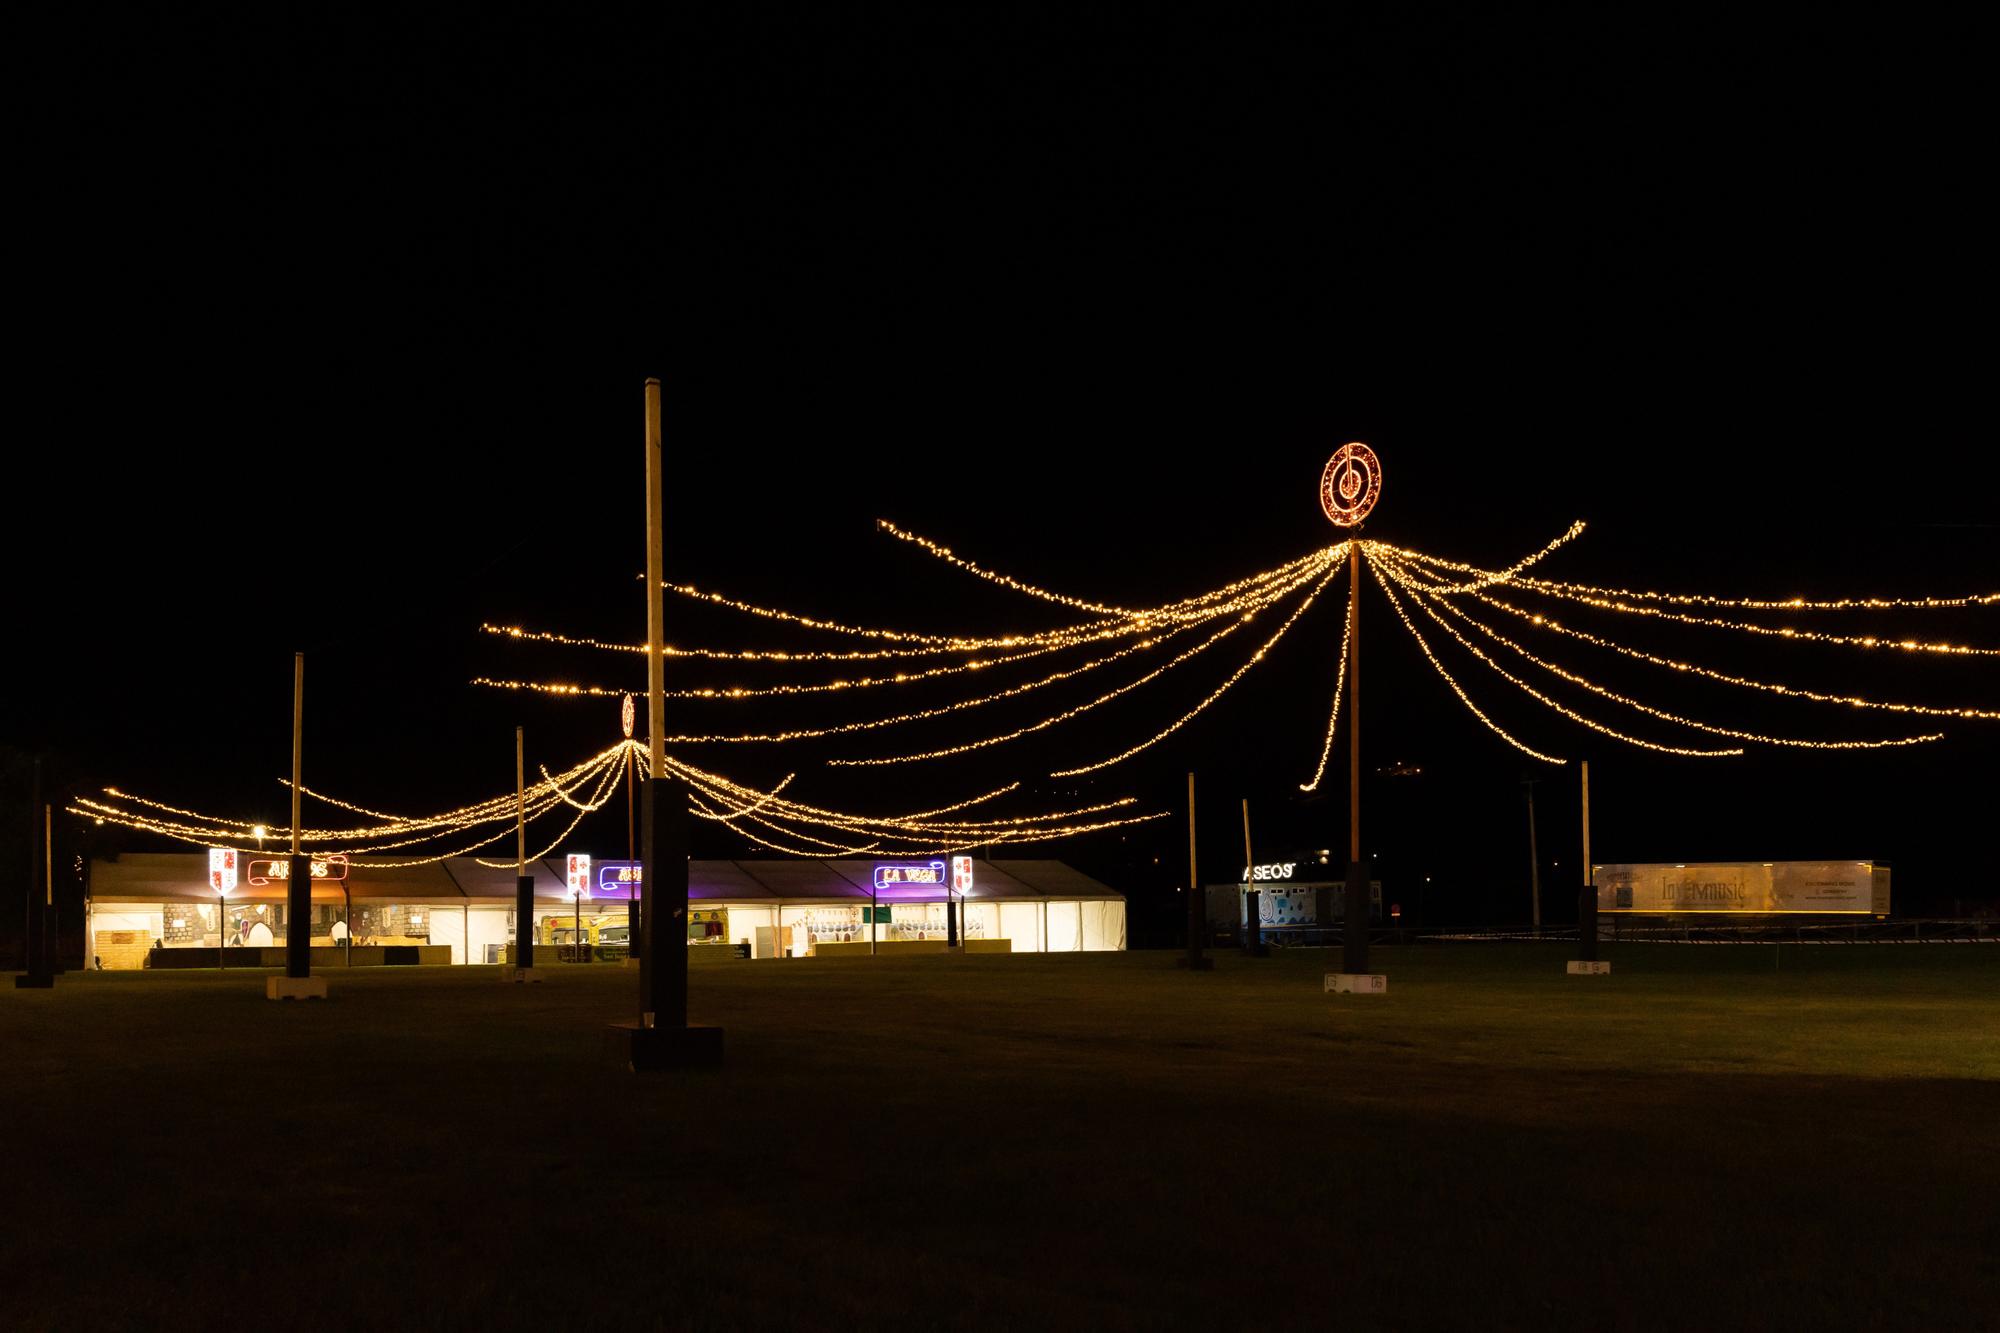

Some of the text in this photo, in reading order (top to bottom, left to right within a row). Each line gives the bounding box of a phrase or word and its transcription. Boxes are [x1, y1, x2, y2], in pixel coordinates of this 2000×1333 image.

[884, 869, 936, 882] LA VEGA
[1243, 863, 1293, 881] ASEOS
